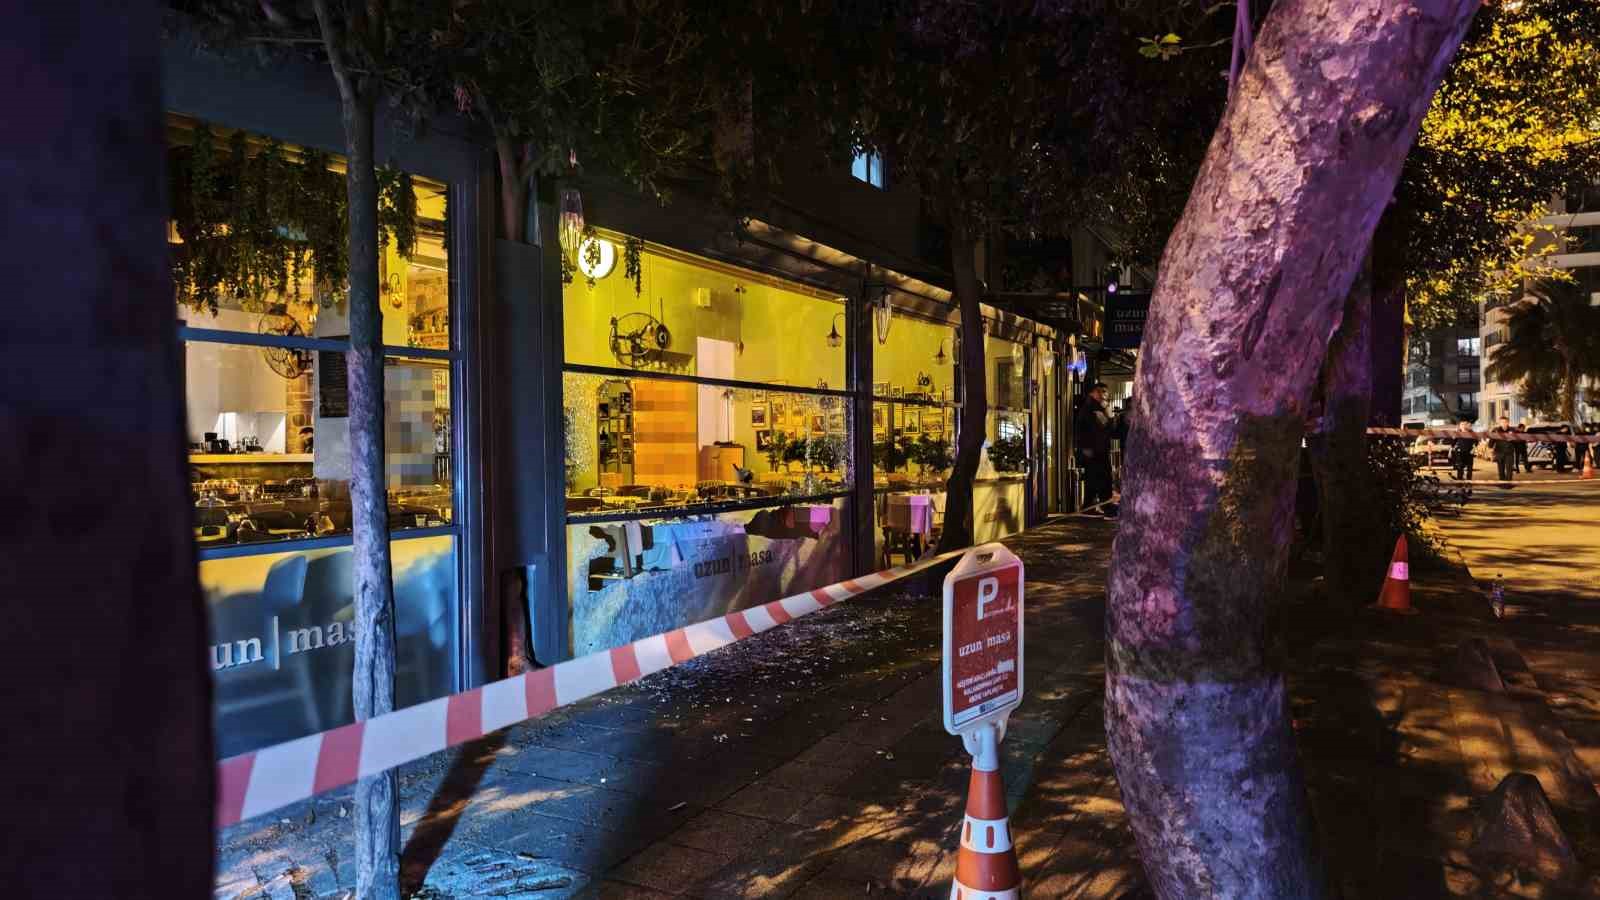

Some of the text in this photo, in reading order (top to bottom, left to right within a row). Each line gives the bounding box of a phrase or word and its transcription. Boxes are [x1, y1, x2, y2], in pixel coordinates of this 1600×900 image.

[694, 557, 731, 579] uzun
[976, 577, 998, 621] P
[958, 631, 1011, 657] uzun masa
